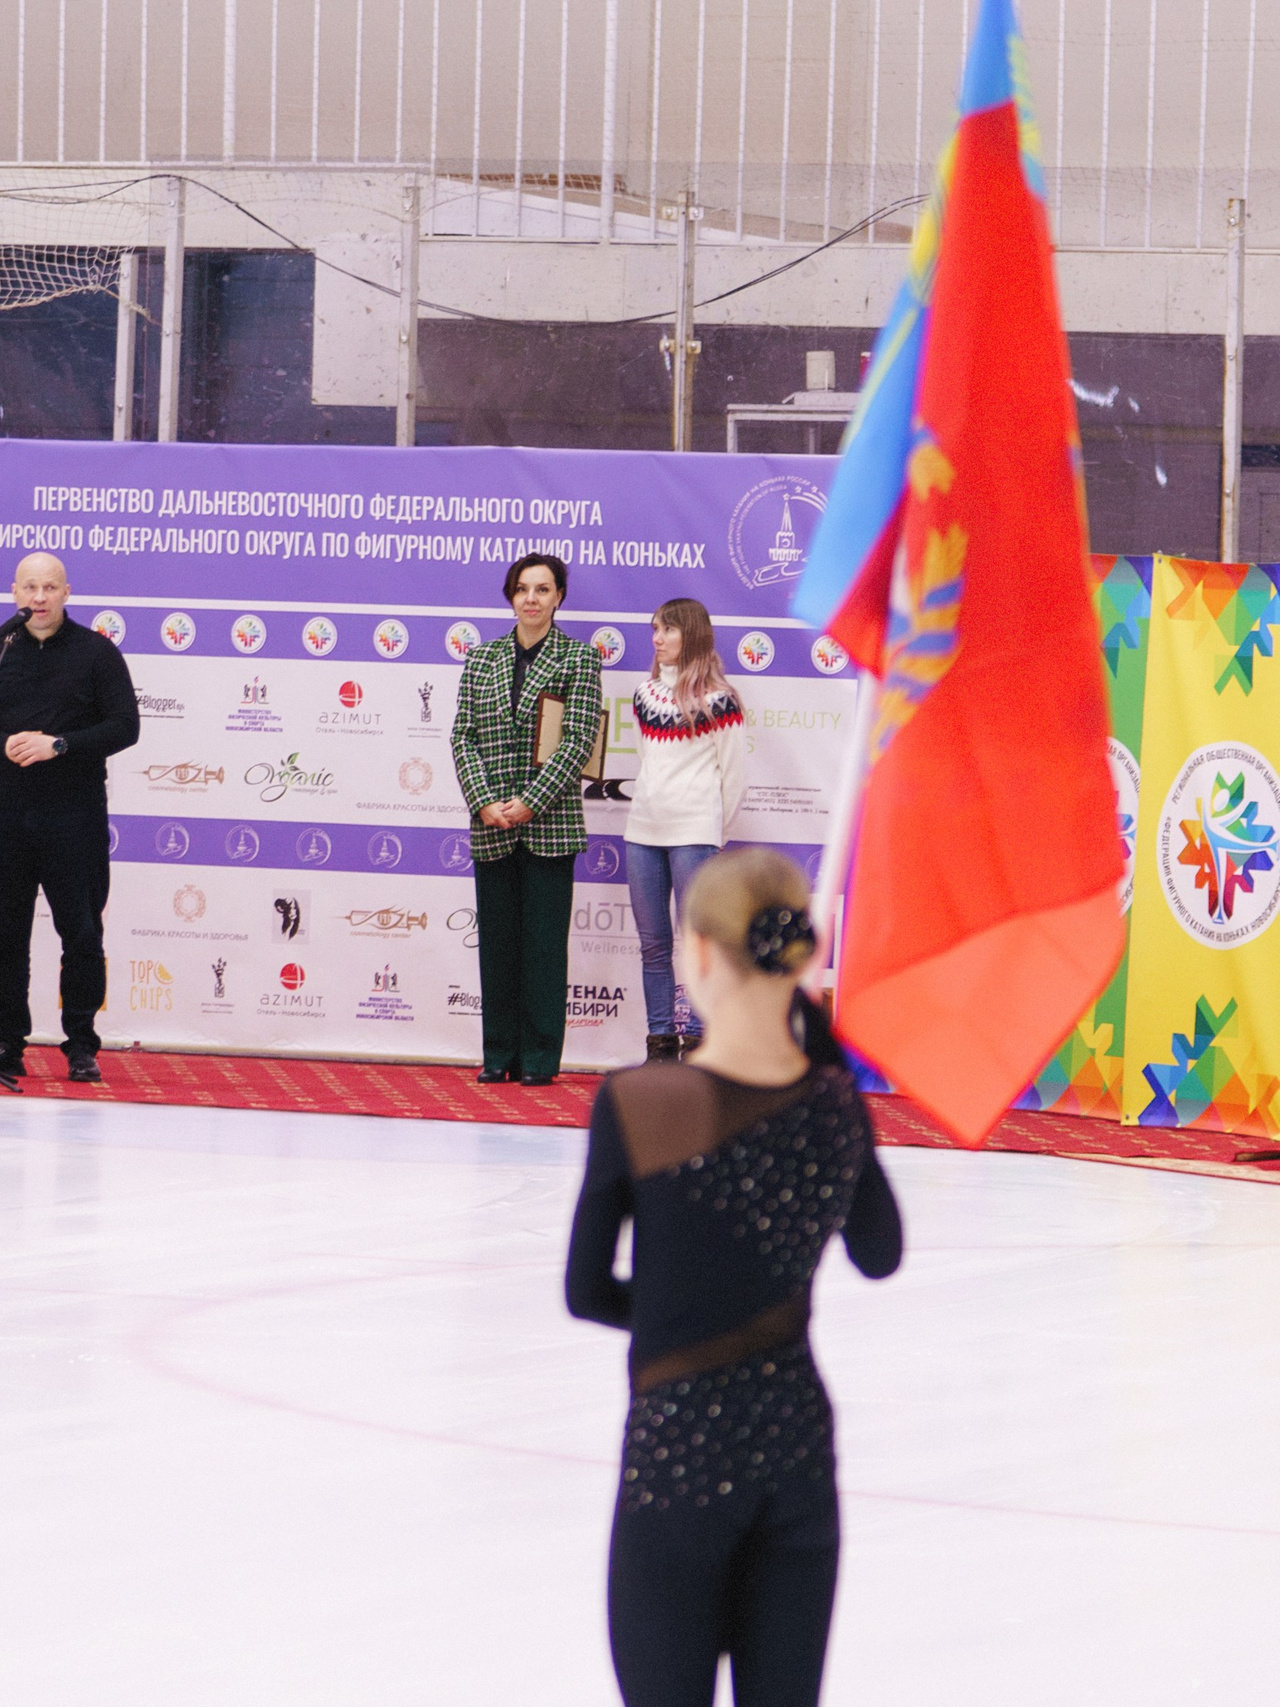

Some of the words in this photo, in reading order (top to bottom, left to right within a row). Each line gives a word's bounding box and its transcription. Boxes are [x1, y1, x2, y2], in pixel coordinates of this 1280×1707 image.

[33, 486, 154, 514] ПЕРВЕНСТВО
[158, 489, 364, 519] ДАЛЬНЕВОСТОЧНОГО
[370, 493, 524, 525] ФЕДЕРАЛЬНОГО
[530, 499, 603, 529] ОКРУГА
[88, 524, 240, 555] ФЕДЕРАЛЬНОГО
[245, 530, 316, 559] ОКРУГА
[321, 532, 350, 558] ПО
[354, 531, 475, 565] ФИГУРНОМУ
[579, 539, 606, 566] НА
[612, 541, 706, 569] КОНЬКАХ
[763, 709, 842, 730] BEAUTY
[244, 762, 335, 802] Organic
[356, 802, 391, 811] ФАБРИКА
[392, 804, 428, 812] КРАСОТЫ
[131, 929, 165, 937] ФАБРИКА
[167, 930, 201, 938] КРАСОТЫ
[210, 932, 249, 941] ЗДОРОВЬЯ
[130, 960, 153, 984] TOP
[130, 986, 173, 1011] CHIPS
